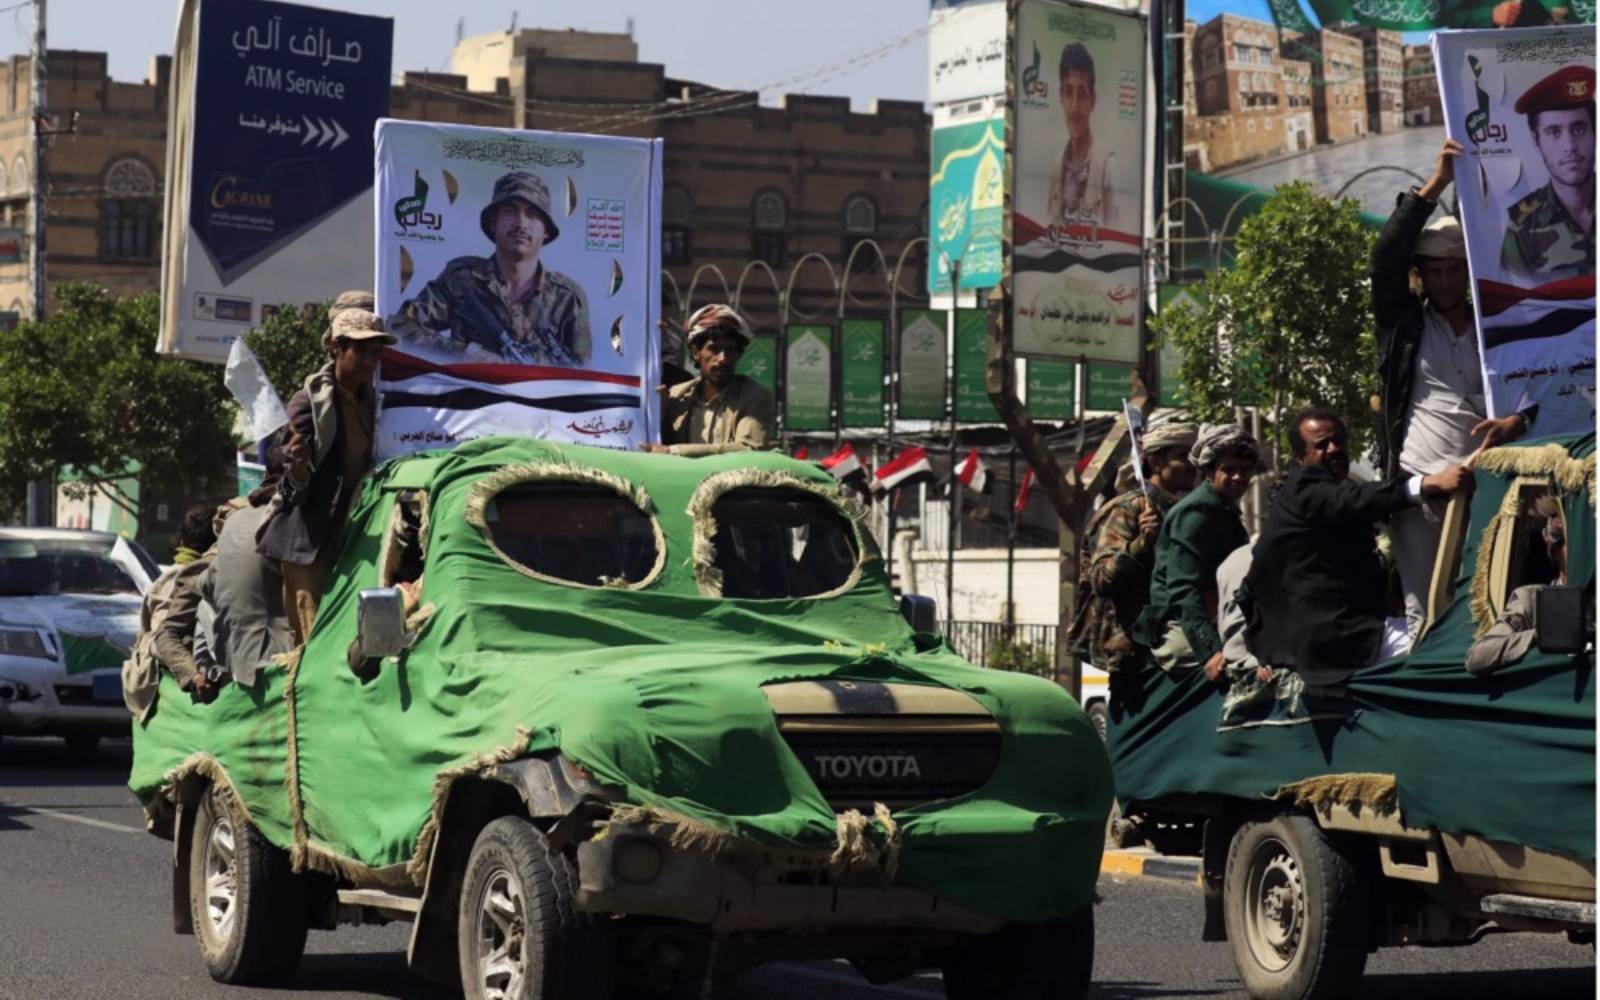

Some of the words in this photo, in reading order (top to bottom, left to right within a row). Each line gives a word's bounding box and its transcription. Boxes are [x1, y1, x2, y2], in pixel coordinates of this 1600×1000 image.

[232, 16, 282, 58] آلي
[289, 27, 362, 66] صراف
[245, 64, 282, 90] ATM
[286, 70, 345, 100] Service
[815, 755, 921, 777] TOYOTA
